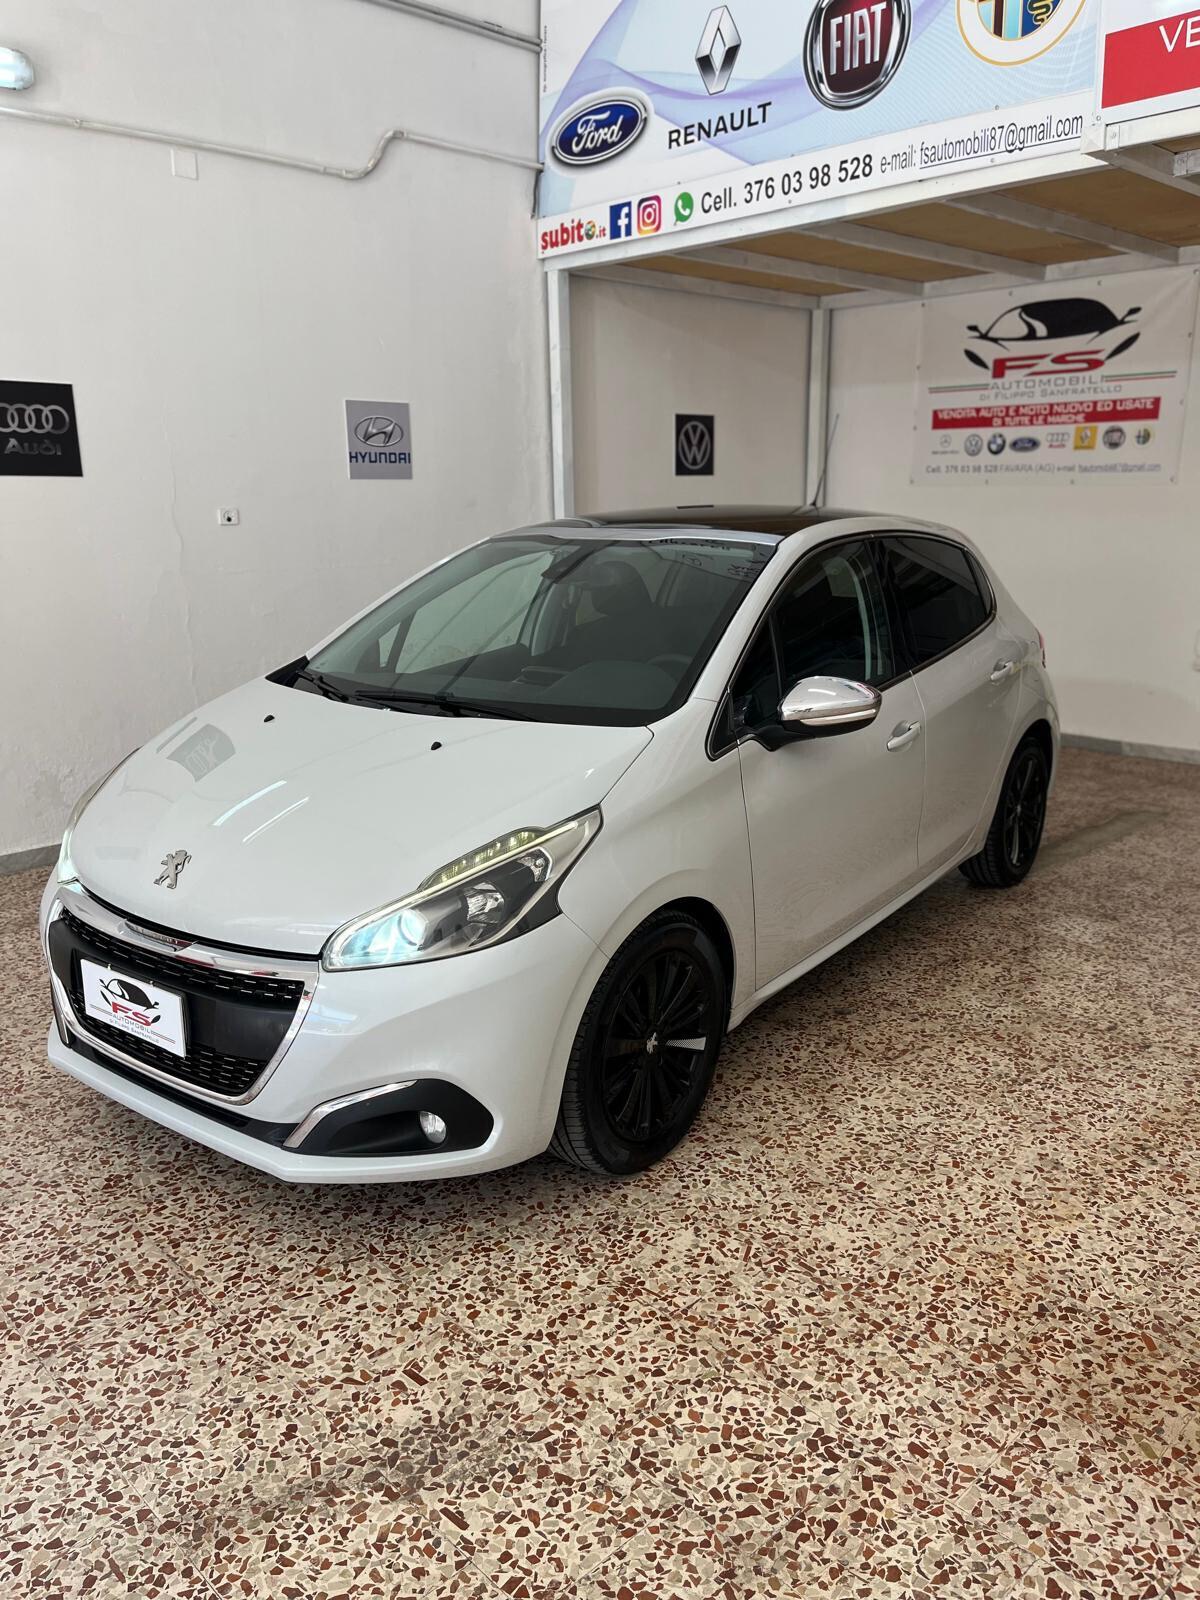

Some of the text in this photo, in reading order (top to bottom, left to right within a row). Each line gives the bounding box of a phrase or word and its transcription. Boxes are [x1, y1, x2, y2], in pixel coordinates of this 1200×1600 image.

[829, 2, 886, 76] FIAT
[572, 110, 623, 154] Ford
[668, 101, 772, 150] RENAULT
[701, 187, 738, 214] Cell.
[744, 177, 775, 204] 376
[782, 171, 803, 195] 03
[809, 164, 831, 190] 98
[838, 154, 873, 183] 528
[880, 144, 916, 174] e-mail:
[919, 115, 1083, 168] fsautomobili87@gmail.com
[992, 349, 1105, 379] FS
[991, 375, 1105, 392] AUTOMOBILI
[937, 399, 1154, 420] VENDITA AUTO E MOTO NUOVO ED USATE
[992, 413, 1086, 427] DI TUTTE LE MARCHE
[4, 437, 62, 456] Audi
[349, 451, 411, 464] HYUNDAI
[111, 1001, 152, 1026] FS
